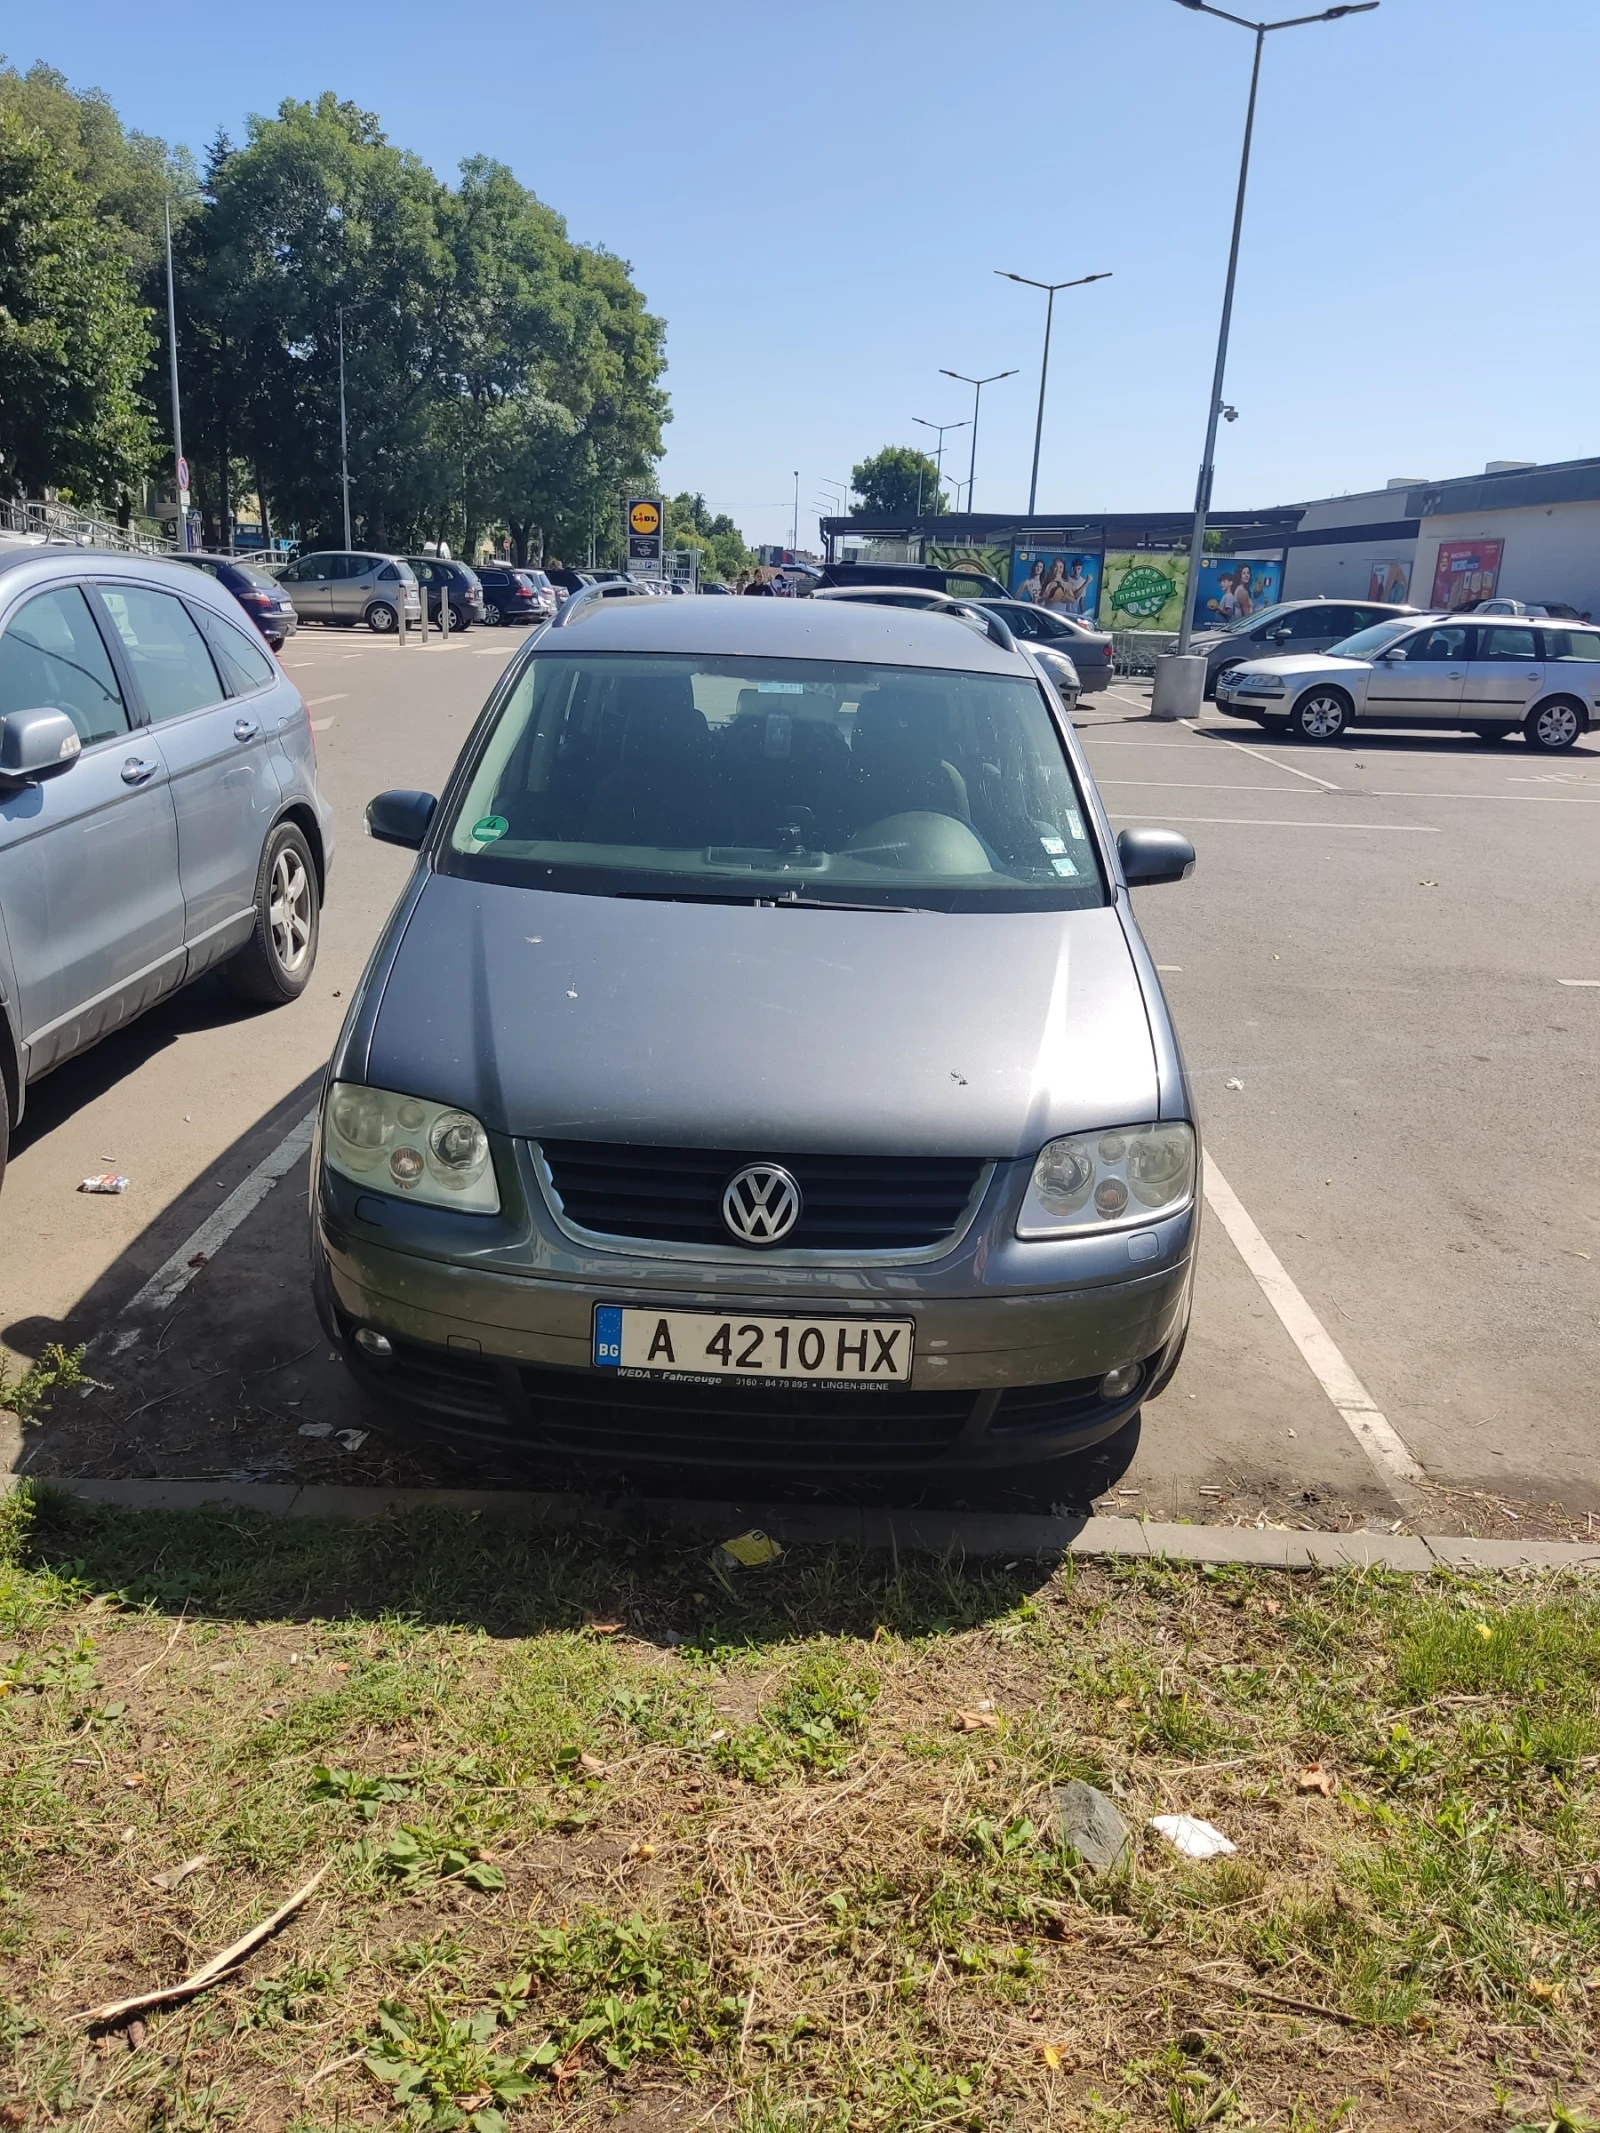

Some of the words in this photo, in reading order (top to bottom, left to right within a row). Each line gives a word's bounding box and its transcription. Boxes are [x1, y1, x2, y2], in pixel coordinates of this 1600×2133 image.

[632, 512, 657, 523] LIDL
[1124, 568, 1151, 586] СВЕЖИ
[1152, 570, 1159, 579] И
[1119, 584, 1167, 601] ПРОВЕРЕНИ
[486, 817, 499, 829] 4
[598, 1343, 619, 1358] BG
[647, 1318, 675, 1363] A
[705, 1322, 825, 1371] 4210
[836, 1328, 901, 1373] HX
[616, 1367, 651, 1380] WEDA
[662, 1371, 723, 1386] Fahrzeuge
[765, 1379, 777, 1388] 84
[778, 1380, 790, 1389] 79
[791, 1380, 809, 1389] 895
[820, 1380, 889, 1391] LINGEN-BIENE
